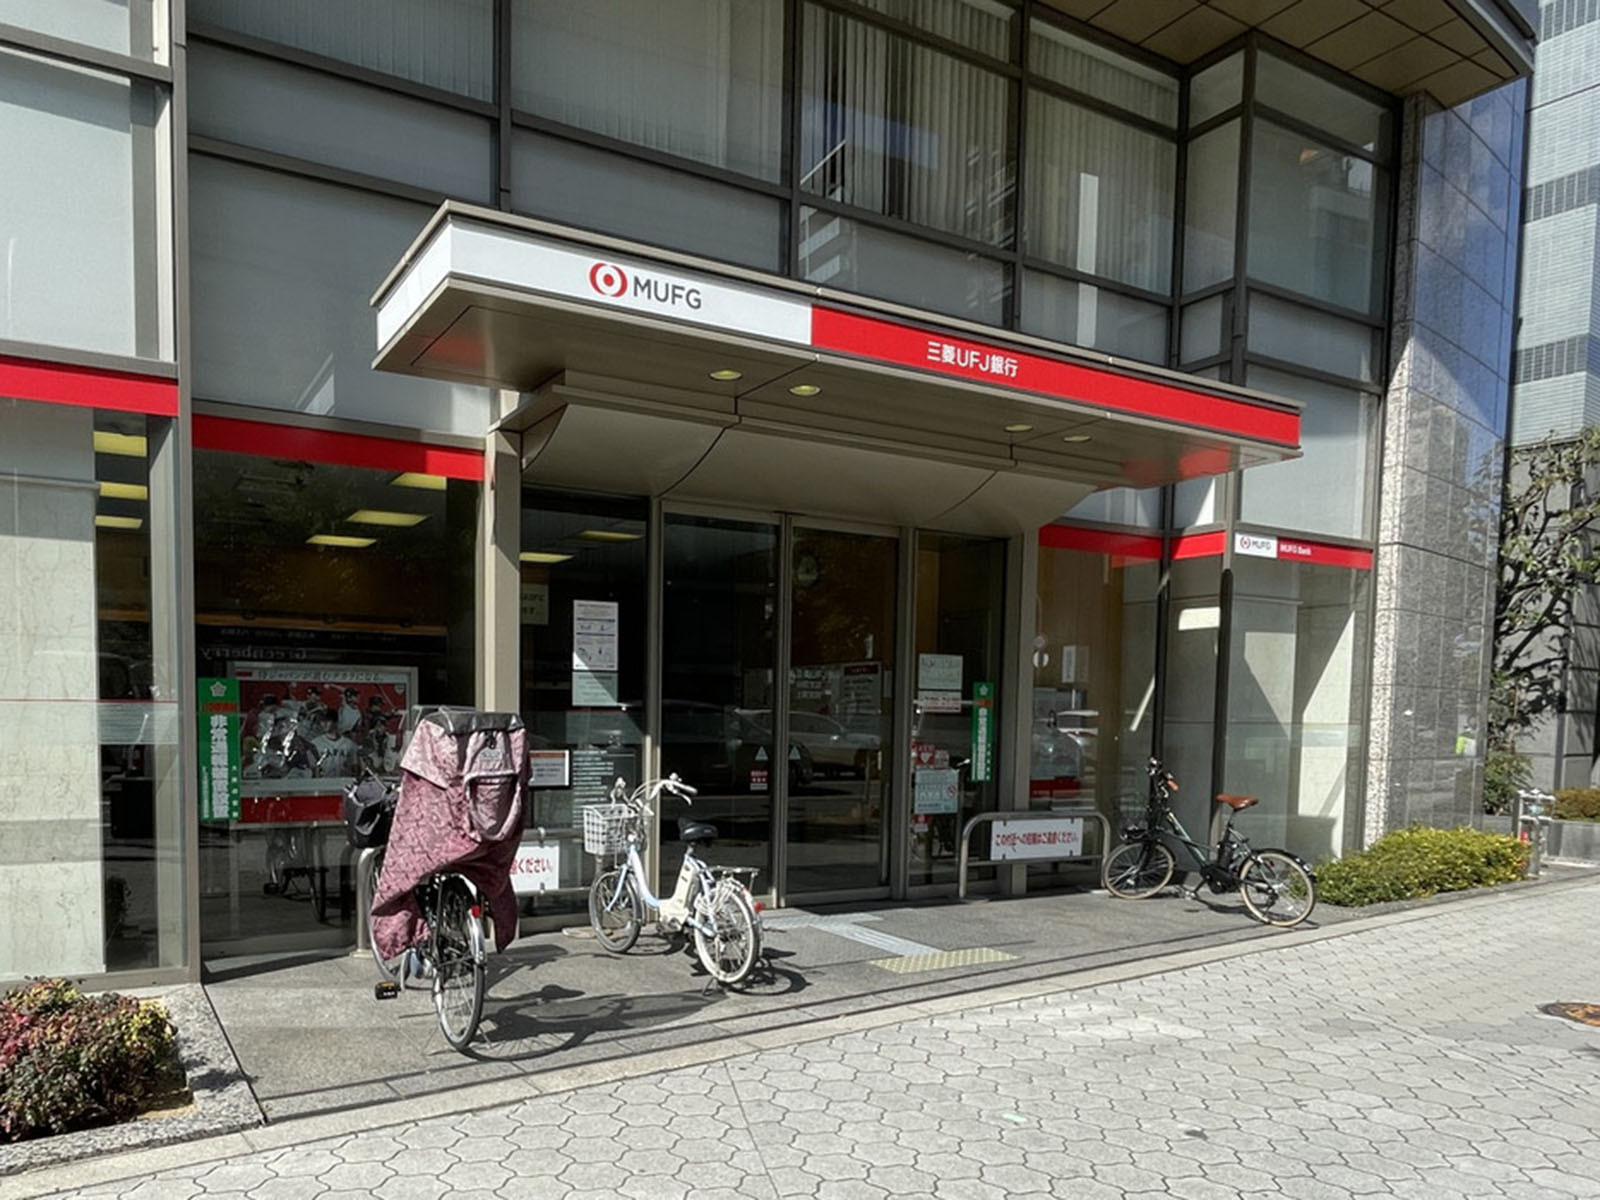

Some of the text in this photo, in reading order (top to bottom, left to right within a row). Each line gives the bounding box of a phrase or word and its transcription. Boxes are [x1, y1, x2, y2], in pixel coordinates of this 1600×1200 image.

[633, 275, 702, 310] MUFG
[926, 340, 1019, 377] 三菱UFJ銀行
[1252, 540, 1272, 550] MUFG
